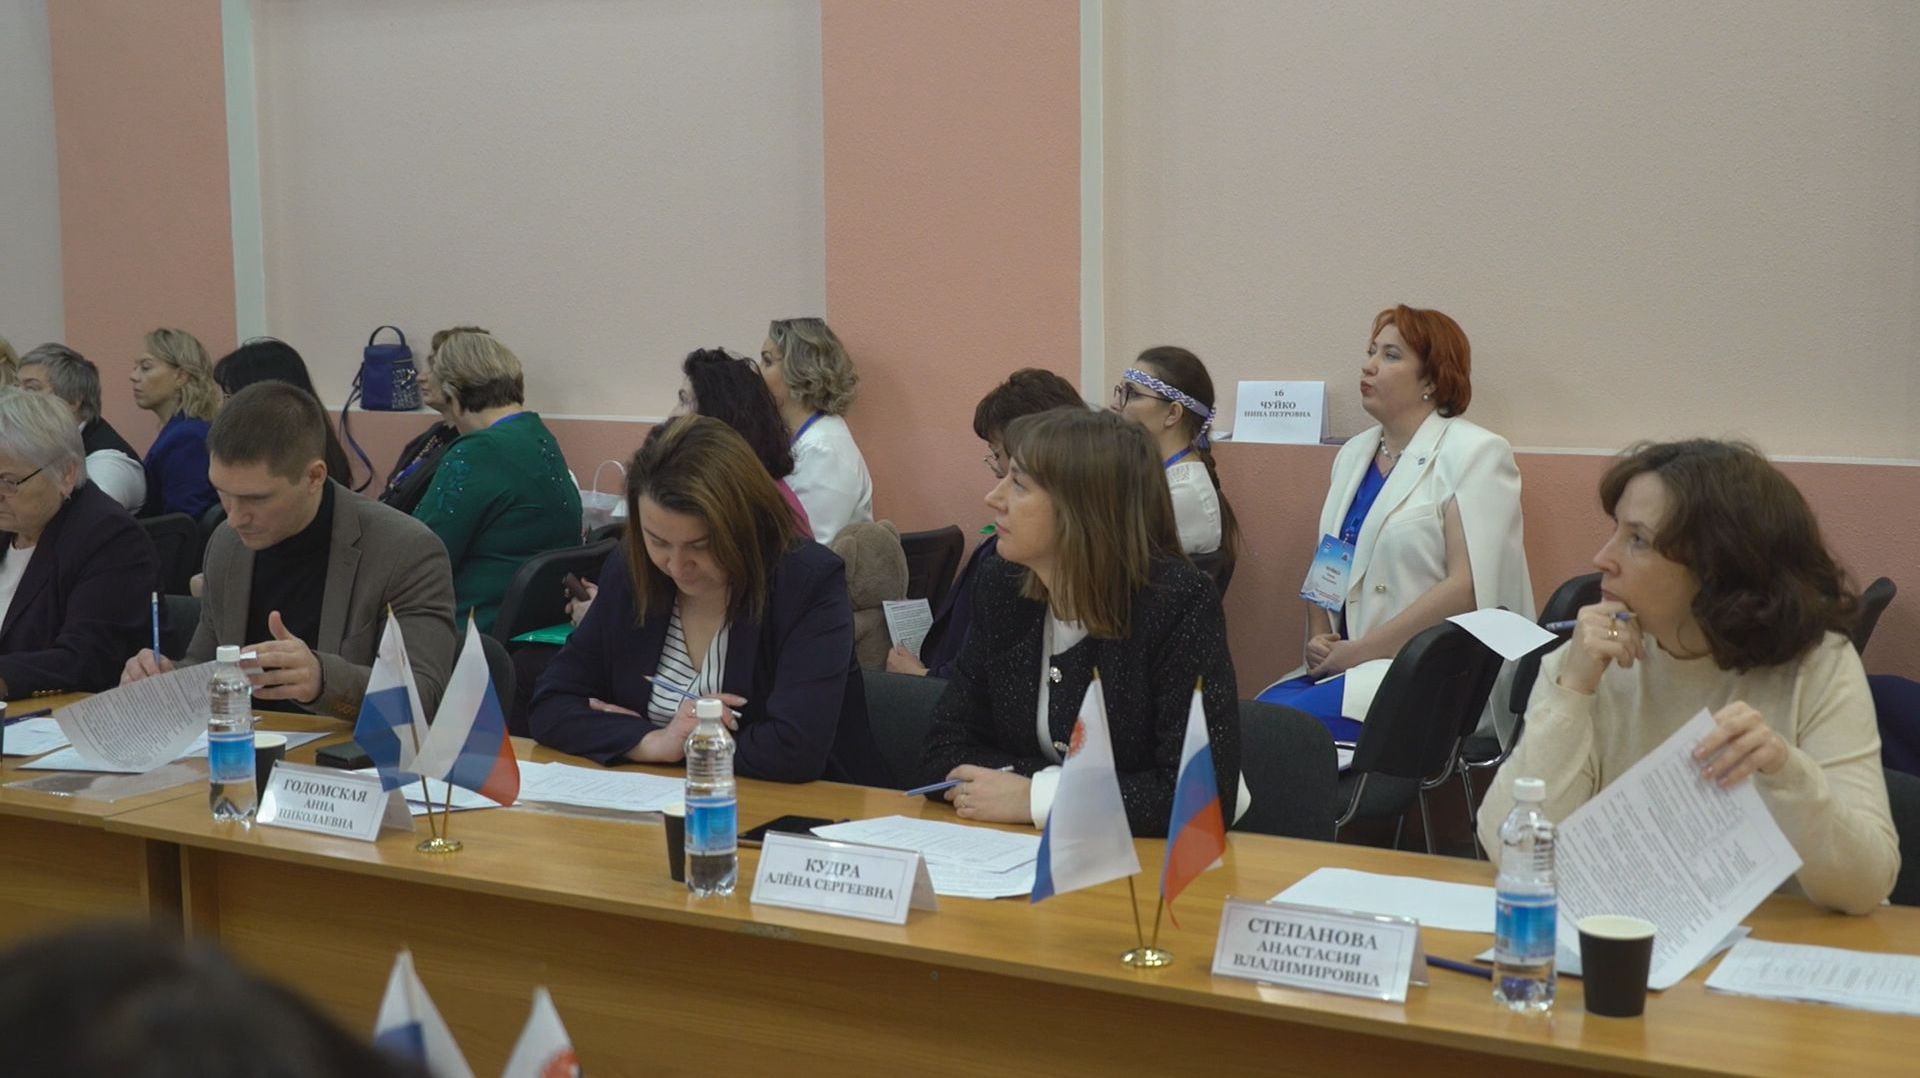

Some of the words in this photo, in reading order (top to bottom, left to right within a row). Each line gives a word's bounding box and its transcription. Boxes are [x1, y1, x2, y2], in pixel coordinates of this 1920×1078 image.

[1274, 389, 1285, 397] 16
[1260, 400, 1297, 410] ЧУЙКО
[1269, 410, 1312, 418] ПЕТРОВНА
[283, 778, 368, 803] ГОДОМСКАЯ
[303, 798, 335, 814] АННА
[278, 808, 354, 831] НИКОЛАЕВНА
[805, 858, 861, 879] КУДРА
[765, 870, 811, 890] АЛЁНА
[814, 879, 894, 901] СЕРГЕЕВНА
[1248, 917, 1378, 951] СТЕПАНОВА
[1256, 940, 1361, 967] АНАСТАСИЯ
[1233, 952, 1381, 988] ВЛАДИМИРОВНА
